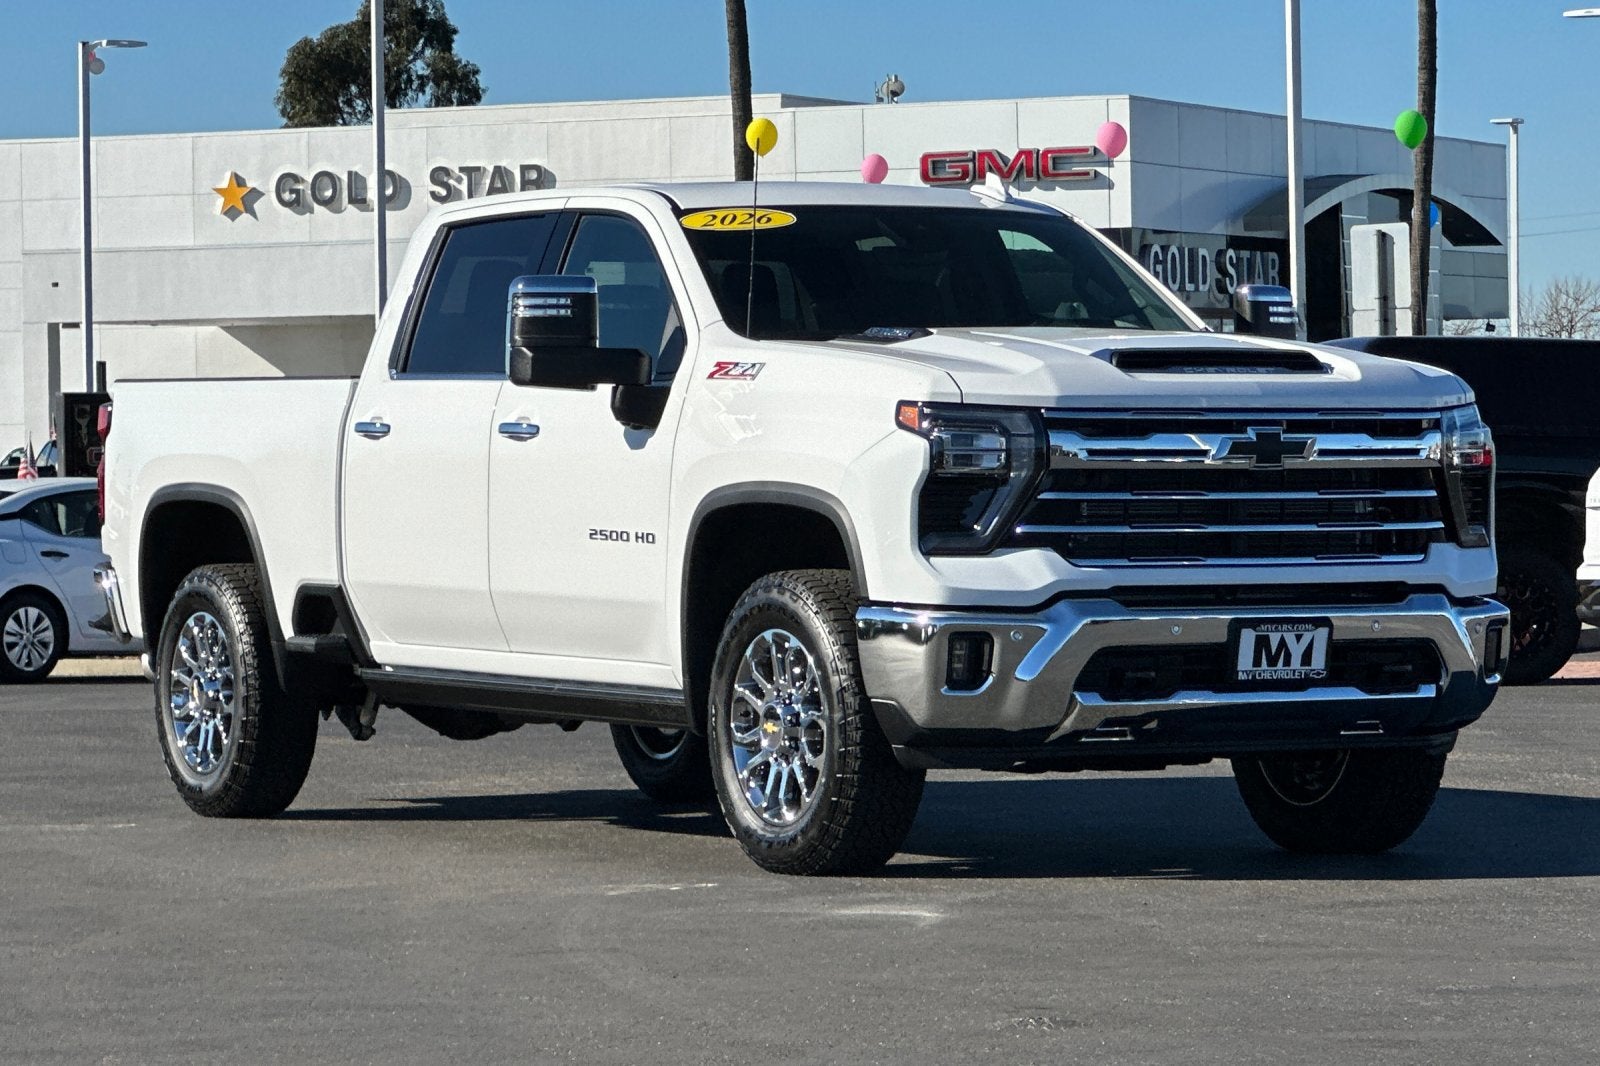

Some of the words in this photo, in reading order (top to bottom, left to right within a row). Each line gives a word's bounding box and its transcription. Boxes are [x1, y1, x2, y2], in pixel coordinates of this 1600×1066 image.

[919, 145, 1096, 185] GMC
[429, 164, 547, 203] STAR
[701, 212, 774, 228] 2026
[1150, 244, 1211, 292] GOLD
[1226, 248, 1280, 295] STAR
[706, 361, 766, 381] Z71
[589, 528, 631, 543] 2500
[635, 531, 656, 544] HD
[1252, 633, 1315, 668] MY
